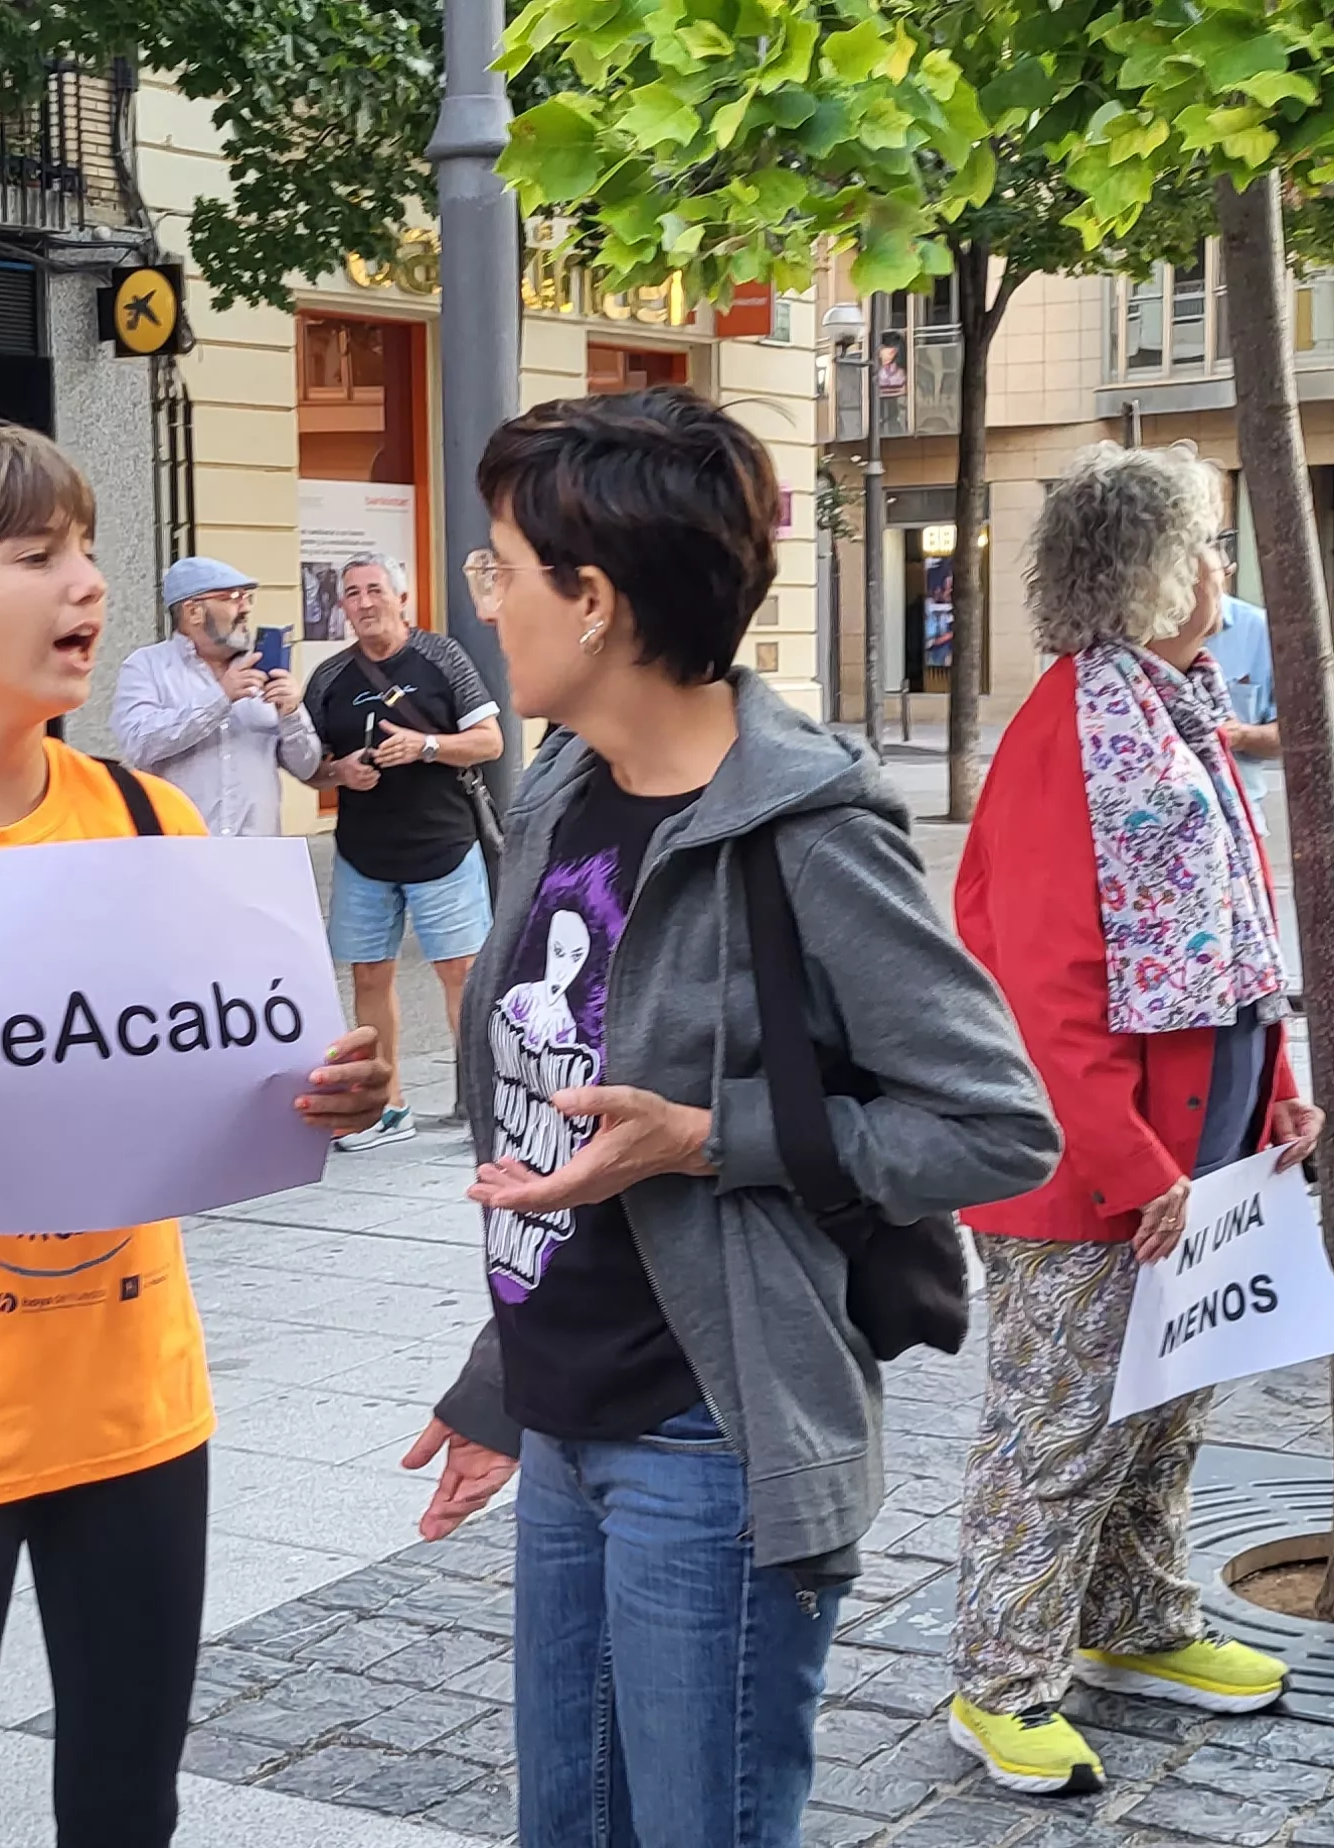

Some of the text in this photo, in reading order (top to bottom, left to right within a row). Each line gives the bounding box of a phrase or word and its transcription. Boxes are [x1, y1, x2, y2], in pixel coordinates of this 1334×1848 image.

[1176, 1191, 1265, 1276] NI UNA
[1158, 1273, 1279, 1359] MENOS
